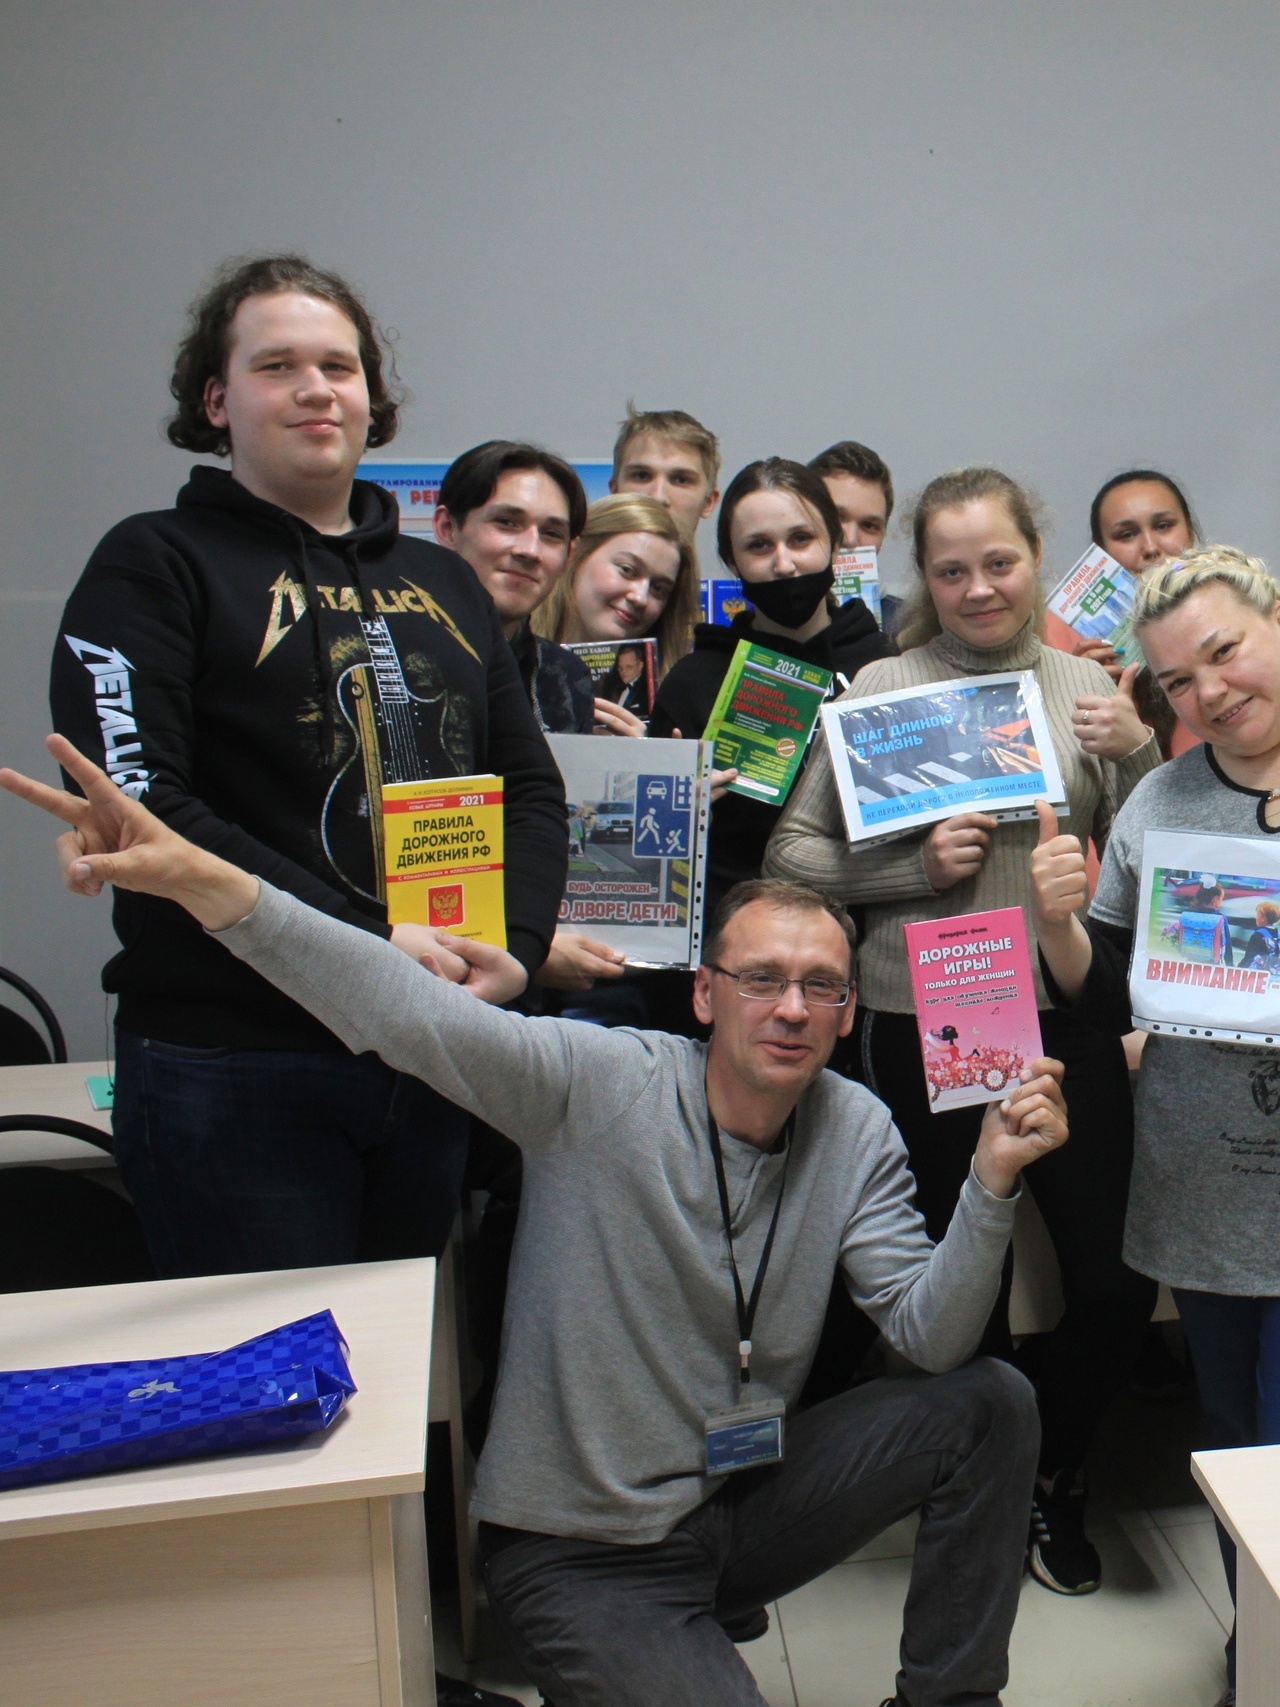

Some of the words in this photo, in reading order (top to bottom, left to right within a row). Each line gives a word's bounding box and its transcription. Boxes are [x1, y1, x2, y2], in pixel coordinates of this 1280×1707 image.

[1063, 564, 1091, 595] ПРАВИЛА
[775, 659, 801, 678] 2021
[741, 678, 786, 701] ПРАВИЛА
[731, 700, 787, 725] ДВИЖЕНИЯ
[735, 689, 799, 717] ДОРОЖНОГО
[852, 728, 884, 744] ШАГ
[890, 713, 954, 738] ДЛИНОЮ
[856, 747, 866, 758] В
[870, 735, 923, 755] ЖИЗНЬ
[459, 794, 486, 807] 2021
[878, 801, 917, 817] ПЕРЕХОДИ
[955, 784, 1016, 799] НЕПОЛОЖЕННОМ
[1018, 780, 1042, 789] МЕСТЕ
[413, 815, 474, 833] ПРАВИЛА
[402, 830, 486, 853] ДОРОЖНОГО
[396, 850, 469, 870] ДВИЖЕНИЯ
[472, 845, 492, 858] РФ
[568, 881, 592, 893] БУДЬ
[594, 883, 650, 894] ОСТОРОЖЕН
[571, 901, 626, 920] ДВОРЕ
[628, 903, 676, 921] ДЕТИ!
[918, 937, 1012, 965] ДОРОЖНЫЕ
[944, 957, 992, 975] ИГРЫ!
[1146, 959, 1269, 995] ВНИМАНИЕ
[924, 979, 957, 990] ТОЛЬКО
[959, 976, 976, 986] ДЛЯ
[978, 969, 1015, 981] ЖЕНЩИН
